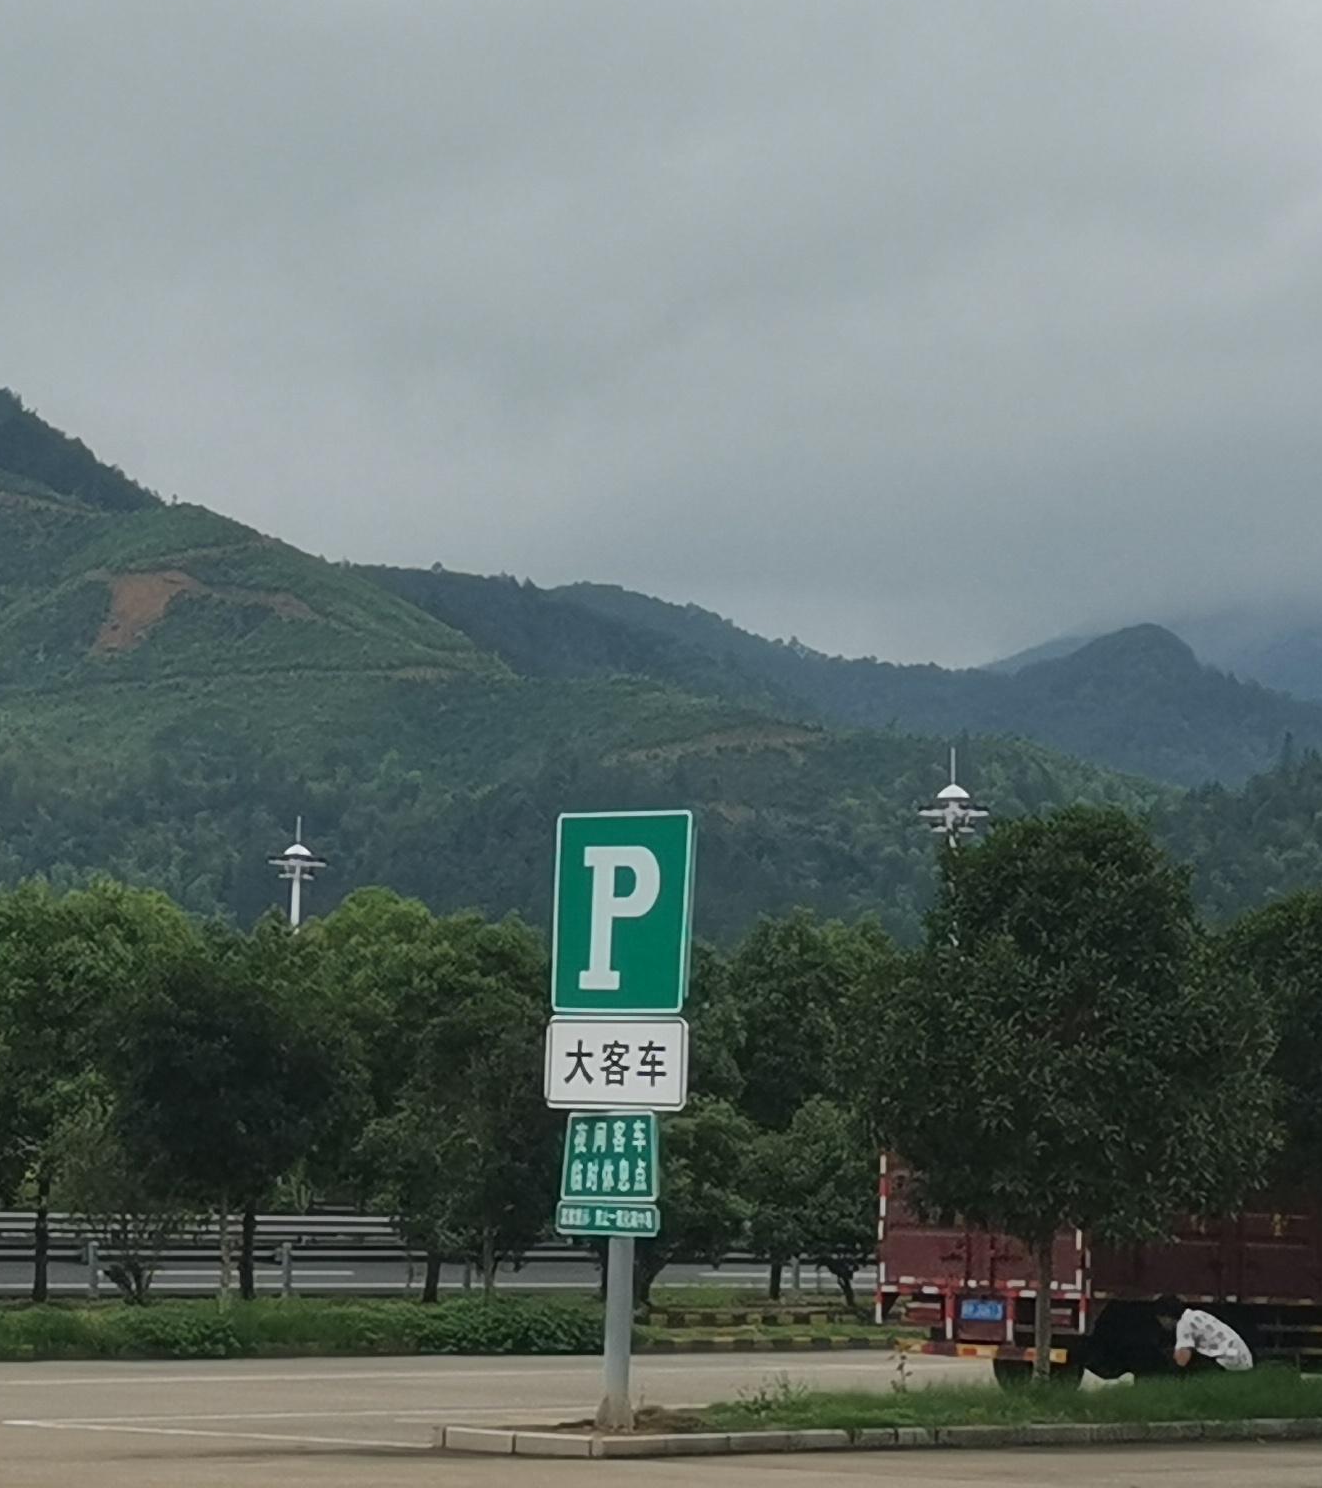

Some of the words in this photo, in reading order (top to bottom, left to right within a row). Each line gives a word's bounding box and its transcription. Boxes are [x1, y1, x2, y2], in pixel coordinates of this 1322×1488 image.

[579, 845, 661, 990] P
[564, 1039, 667, 1087] 大客车
